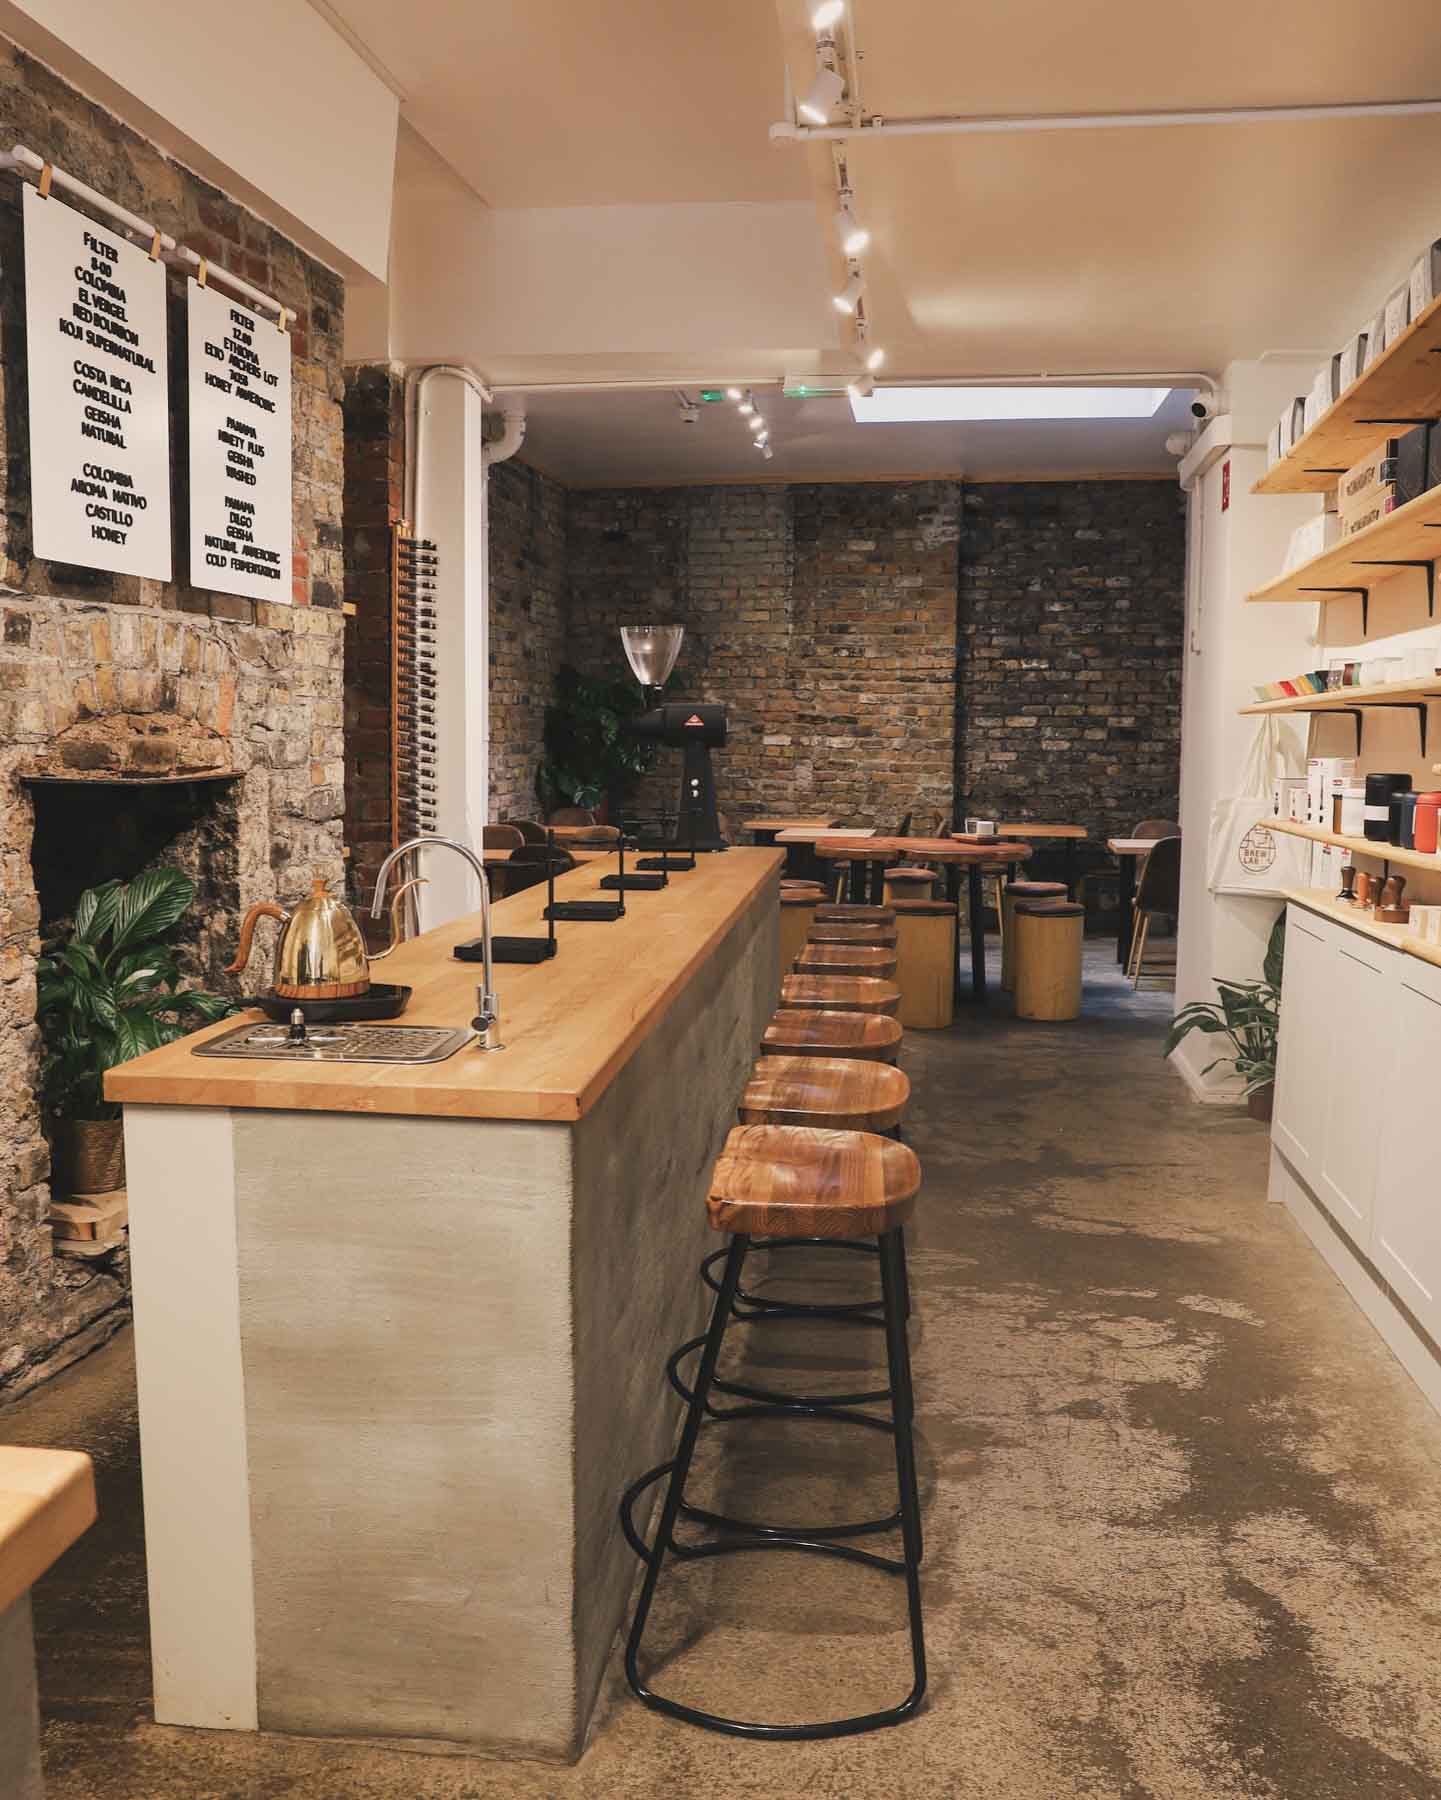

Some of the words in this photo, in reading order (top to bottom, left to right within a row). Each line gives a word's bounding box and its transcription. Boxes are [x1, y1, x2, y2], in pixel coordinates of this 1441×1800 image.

[83, 232, 119, 263] FILTER
[74, 266, 127, 303] COLOMBIA
[79, 287, 91, 306] EL
[91, 293, 128, 322] VERGEL
[73, 303, 93, 323] RED
[93, 312, 139, 346] BOURBON
[230, 309, 255, 333] FILTER
[59, 318, 84, 341] KOJI
[86, 330, 156, 374] SUPERNATURAL
[223, 337, 260, 365] ETHIOPIA
[73, 360, 107, 385] COSTA
[110, 374, 132, 395] RICA
[263, 371, 279, 387] LOT
[73, 379, 132, 414] CANDELILLA
[204, 371, 232, 394] HONEY
[235, 386, 276, 413] ANAEROBIC
[84, 405, 121, 430] GEISHA
[226, 416, 257, 439] PANAMA
[81, 421, 127, 449] NATURAL
[218, 429, 245, 450] NINETY
[247, 441, 265, 458] PLUS
[227, 449, 254, 469] GEISHA
[83, 463, 133, 488] COLOMBIA
[225, 464, 257, 486] WASHED
[71, 478, 108, 500] AROMA
[112, 488, 147, 510] NATIVO
[224, 495, 255, 515] PANAMA
[85, 503, 133, 527] CASTILLO
[91, 524, 127, 545] HONEY
[226, 525, 254, 543] GEISHA
[204, 534, 239, 554] NATURAL
[241, 544, 281, 564] ANAEROBIC
[205, 552, 227, 567] COLD
